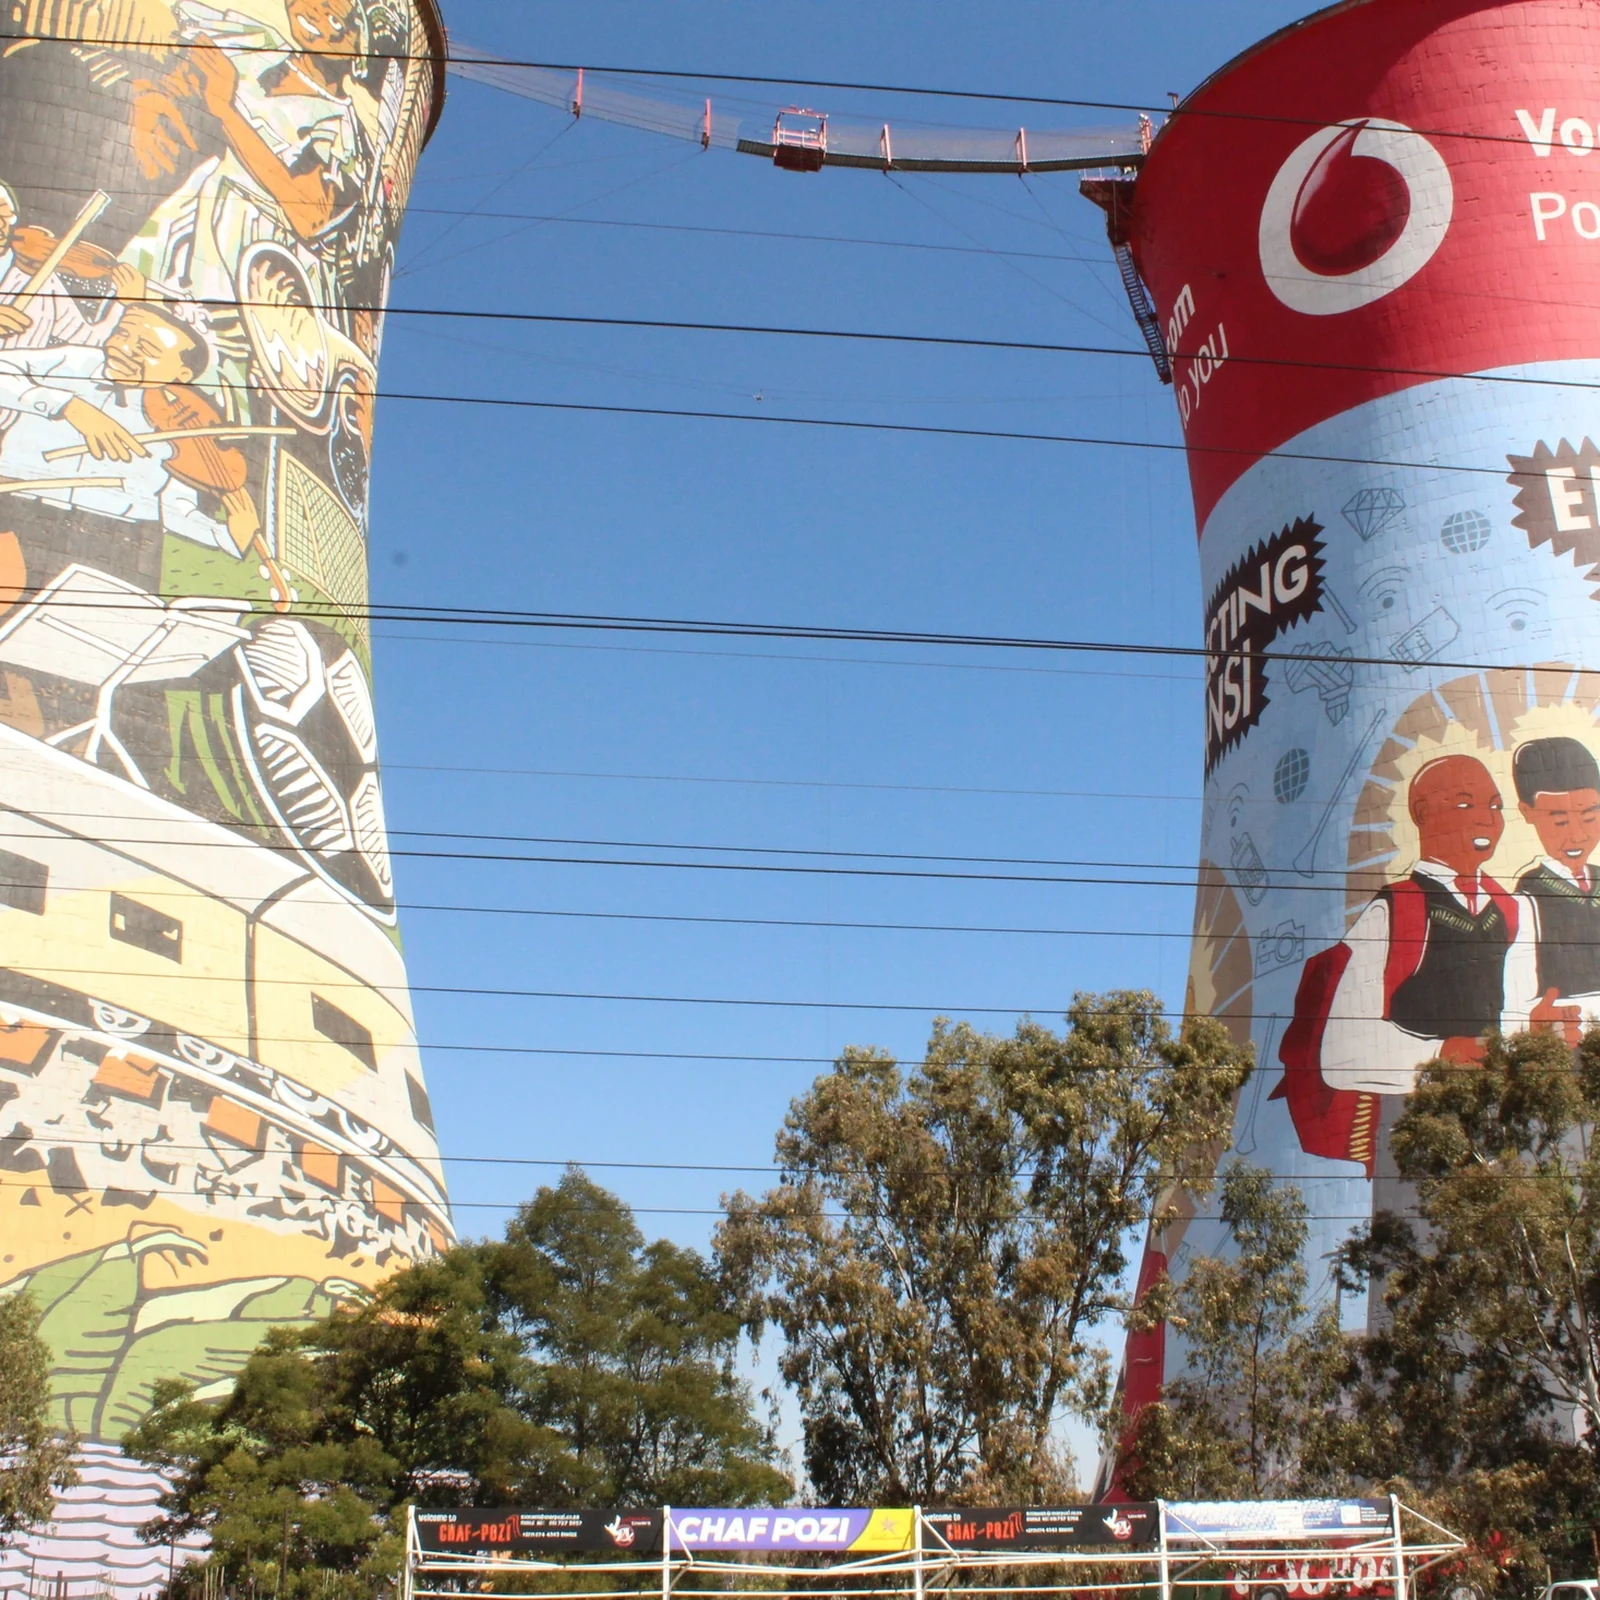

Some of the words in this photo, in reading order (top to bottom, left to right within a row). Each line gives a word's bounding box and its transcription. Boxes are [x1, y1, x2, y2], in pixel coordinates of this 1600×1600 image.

[1514, 107, 1600, 157] Vo
[1529, 191, 1600, 241] Po
[1188, 322, 1229, 409] you
[1545, 465, 1600, 532] E
[1206, 544, 1309, 676] CTING
[1206, 637, 1252, 766] NSI
[418, 1513, 447, 1522] welcome
[449, 1513, 457, 1522] to
[677, 1516, 768, 1542] CHAF
[772, 1516, 850, 1542] POZI
[953, 1513, 961, 1521] to
